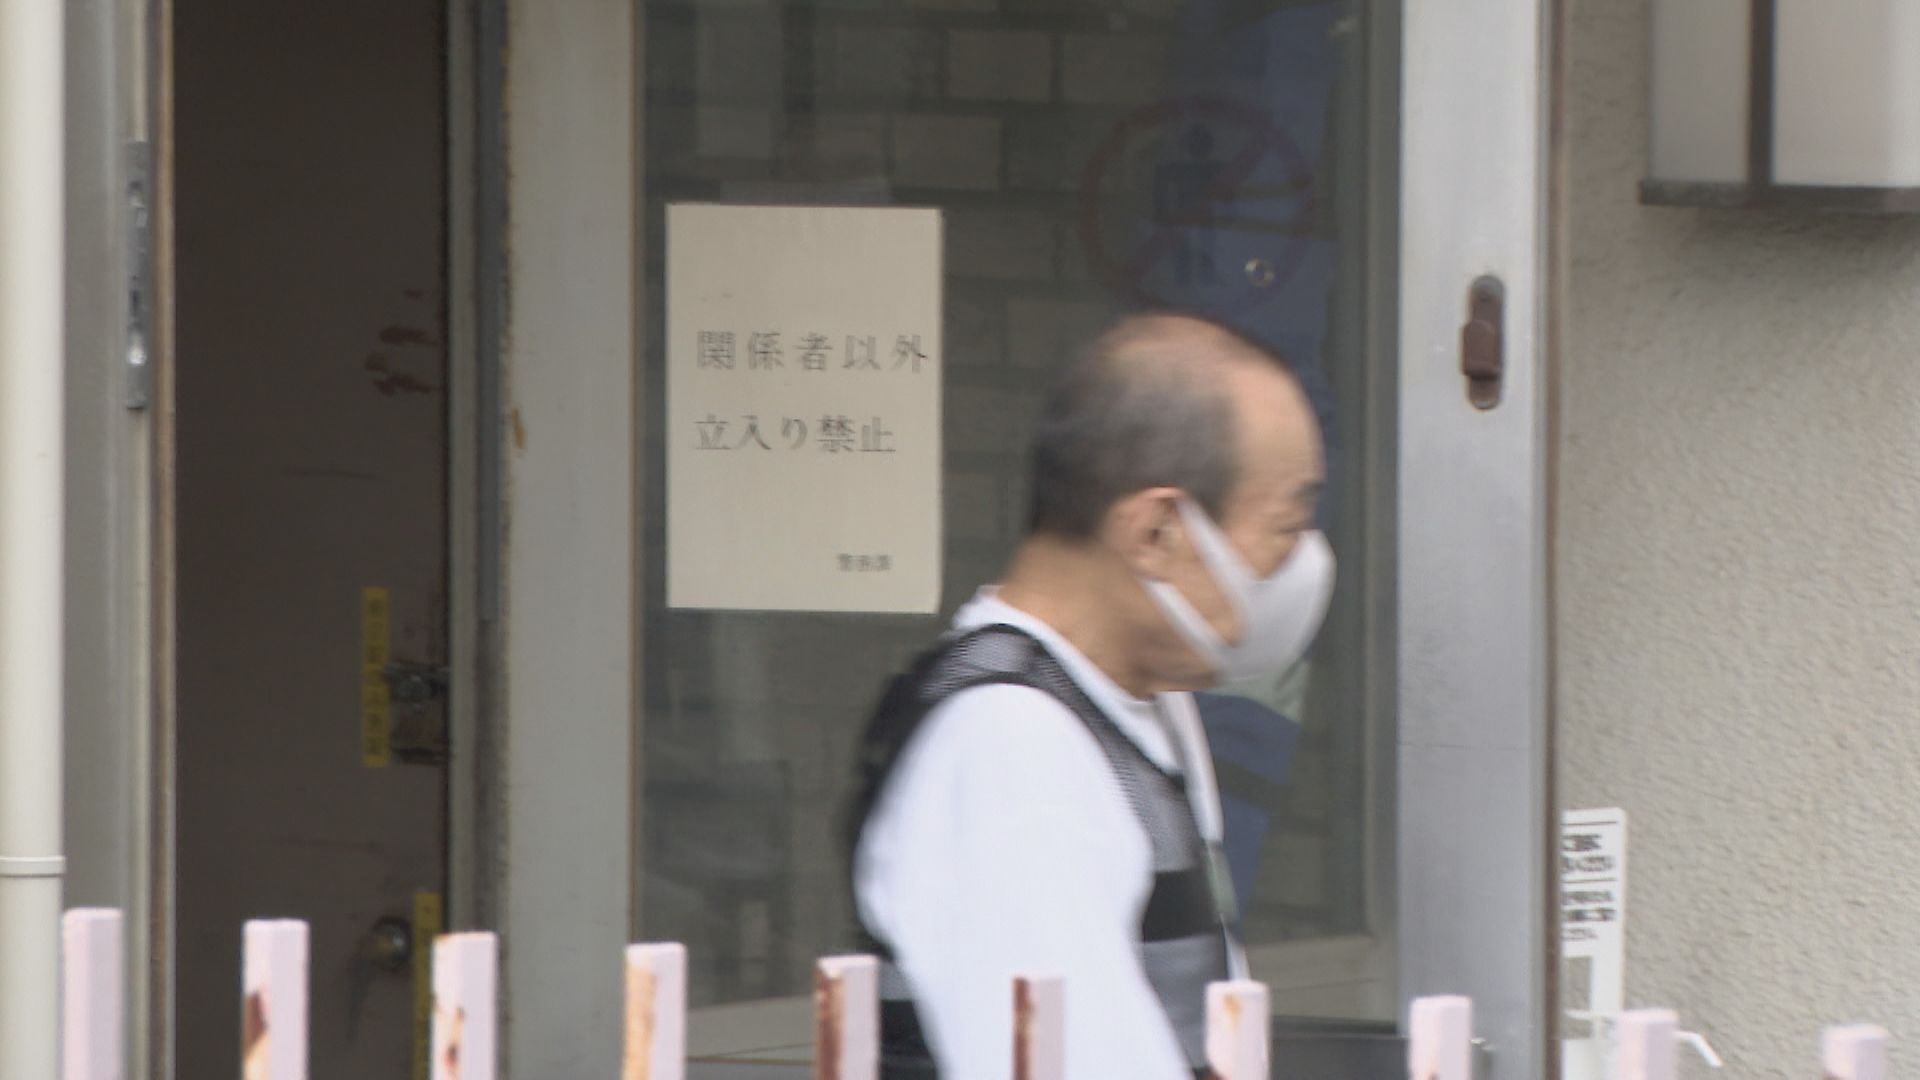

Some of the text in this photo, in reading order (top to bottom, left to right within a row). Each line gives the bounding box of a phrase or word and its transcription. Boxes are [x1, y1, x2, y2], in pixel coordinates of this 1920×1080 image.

[696, 331, 928, 374] 関係者以外
[694, 414, 896, 454] 立入り禁止
